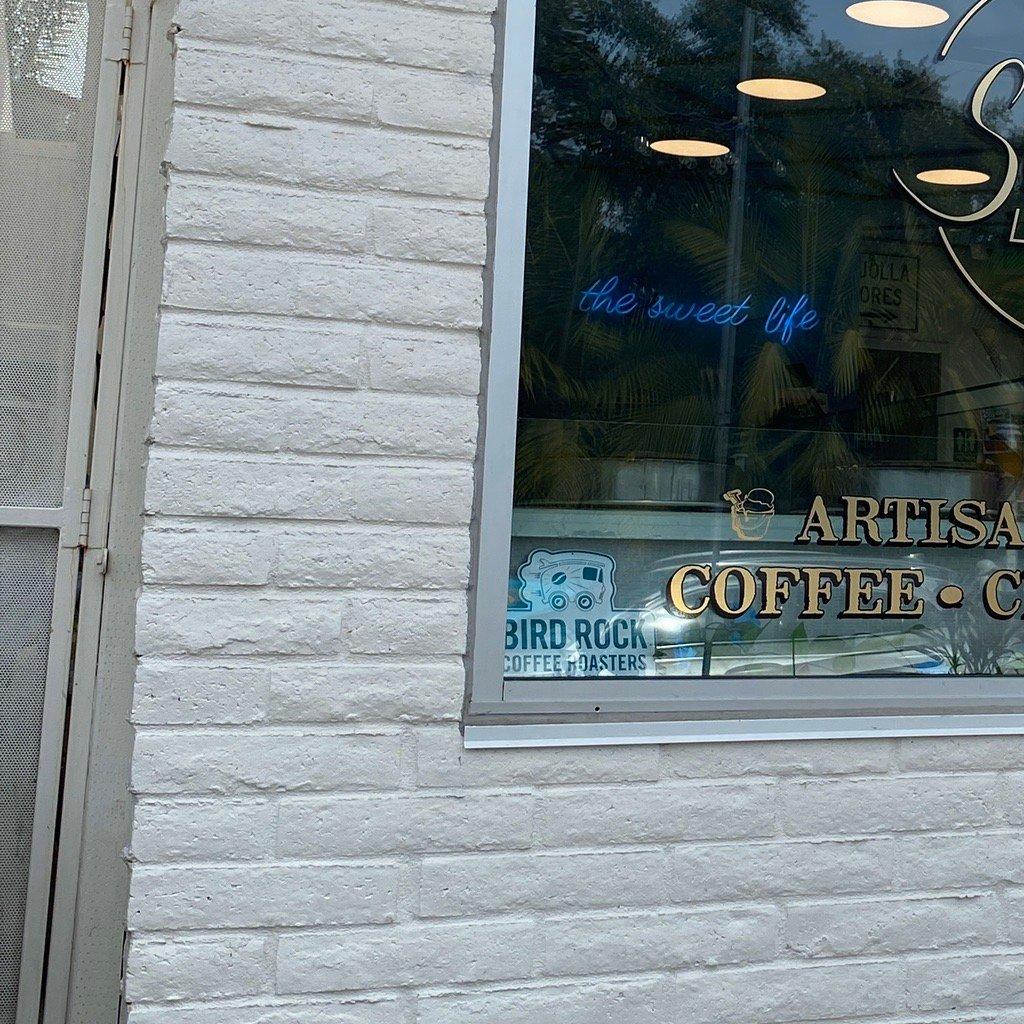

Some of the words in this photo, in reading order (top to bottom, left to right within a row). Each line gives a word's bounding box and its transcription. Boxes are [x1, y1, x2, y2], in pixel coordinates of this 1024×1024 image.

[579, 275, 639, 315] the
[648, 293, 751, 327] sweet
[764, 293, 821, 346] life
[666, 564, 925, 619] COFFEE
[505, 618, 567, 649] BIRD
[574, 618, 648, 650] ROCK
[503, 654, 562, 672] COFFEE
